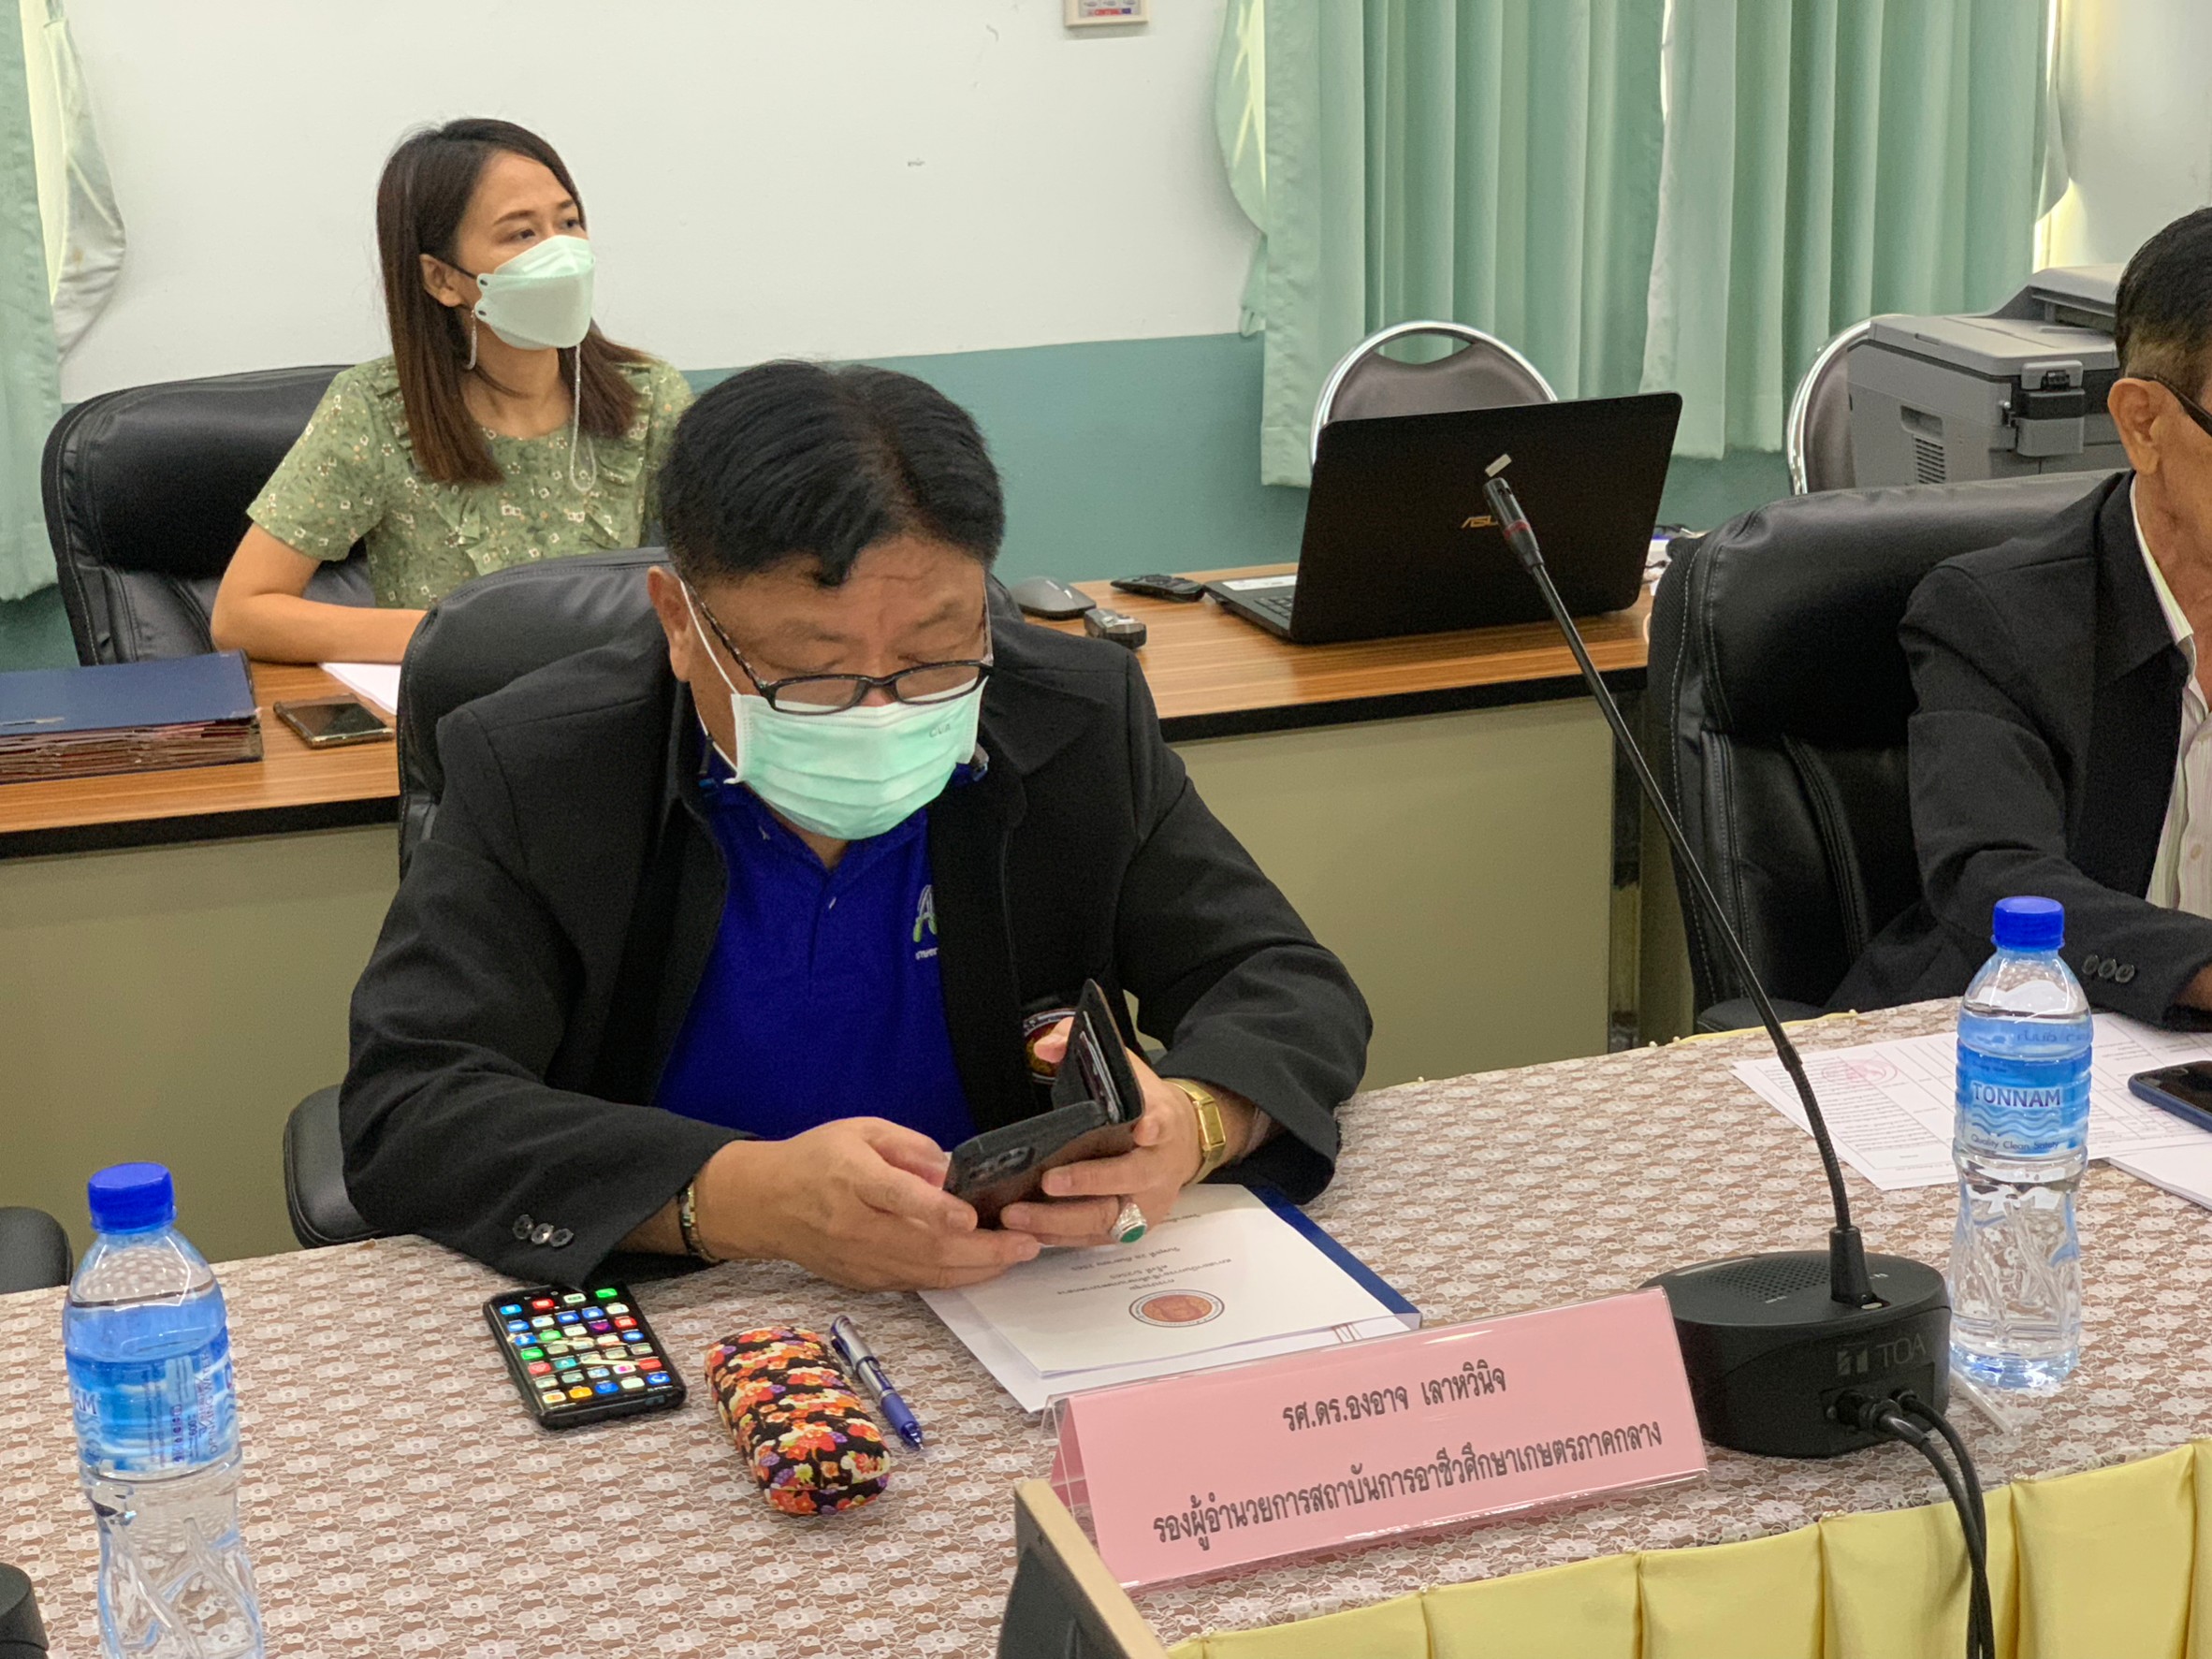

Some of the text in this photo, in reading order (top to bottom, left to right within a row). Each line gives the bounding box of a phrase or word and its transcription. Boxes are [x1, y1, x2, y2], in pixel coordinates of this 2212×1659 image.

[1972, 1082, 2060, 1108] TONNAM
[1971, 1133, 2000, 1149] Quality
[2002, 1140, 2030, 1151] Clean
[1876, 1332, 1927, 1368] TOA
[1282, 1359, 1507, 1432] รศ.ดร.องอาจ เลาหวินิจ
[1153, 1421, 1663, 1550] รองผู้อำนวยการสถาบันการอาชีวศึกษาเกษตรภาคกลาง
